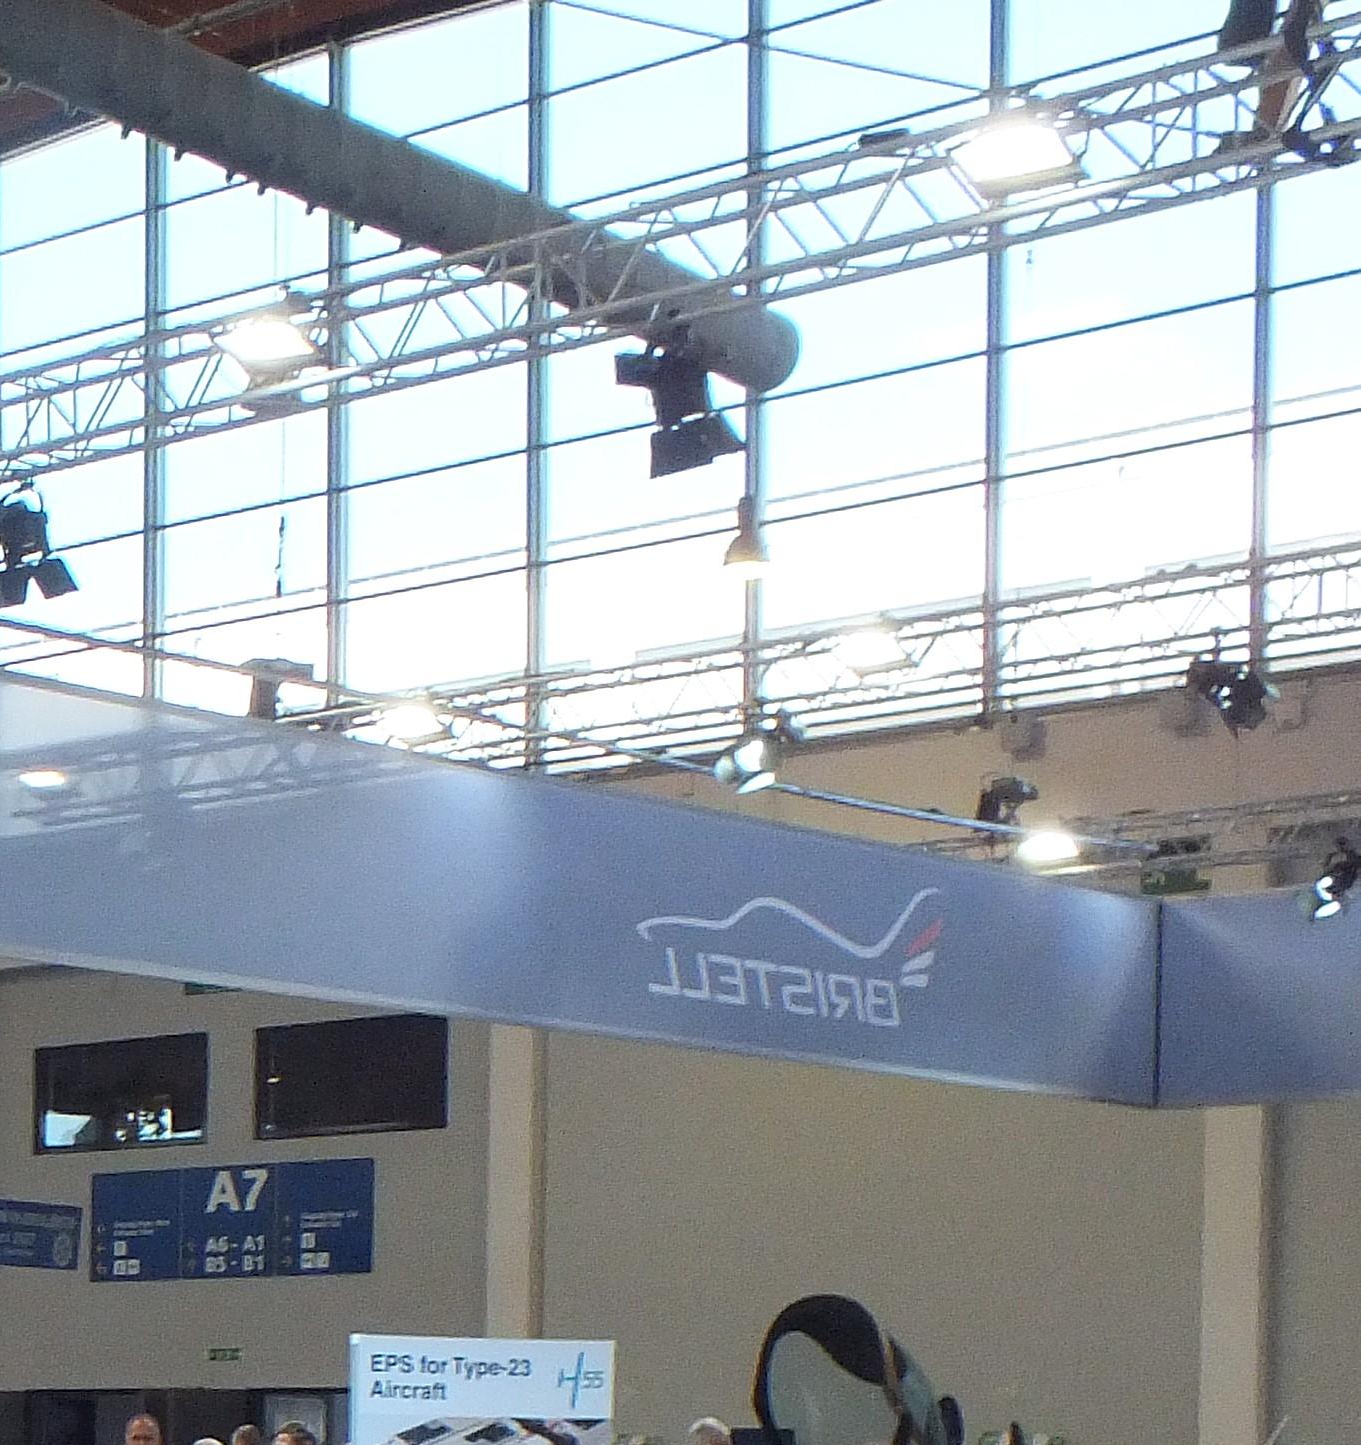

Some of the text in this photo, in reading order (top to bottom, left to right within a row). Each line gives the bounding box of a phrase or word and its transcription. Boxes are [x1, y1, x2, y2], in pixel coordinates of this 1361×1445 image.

[204, 1168, 269, 1214] A7
[371, 1354, 532, 1381] EPS for Type-23
[370, 1380, 448, 1401] Aircraft
